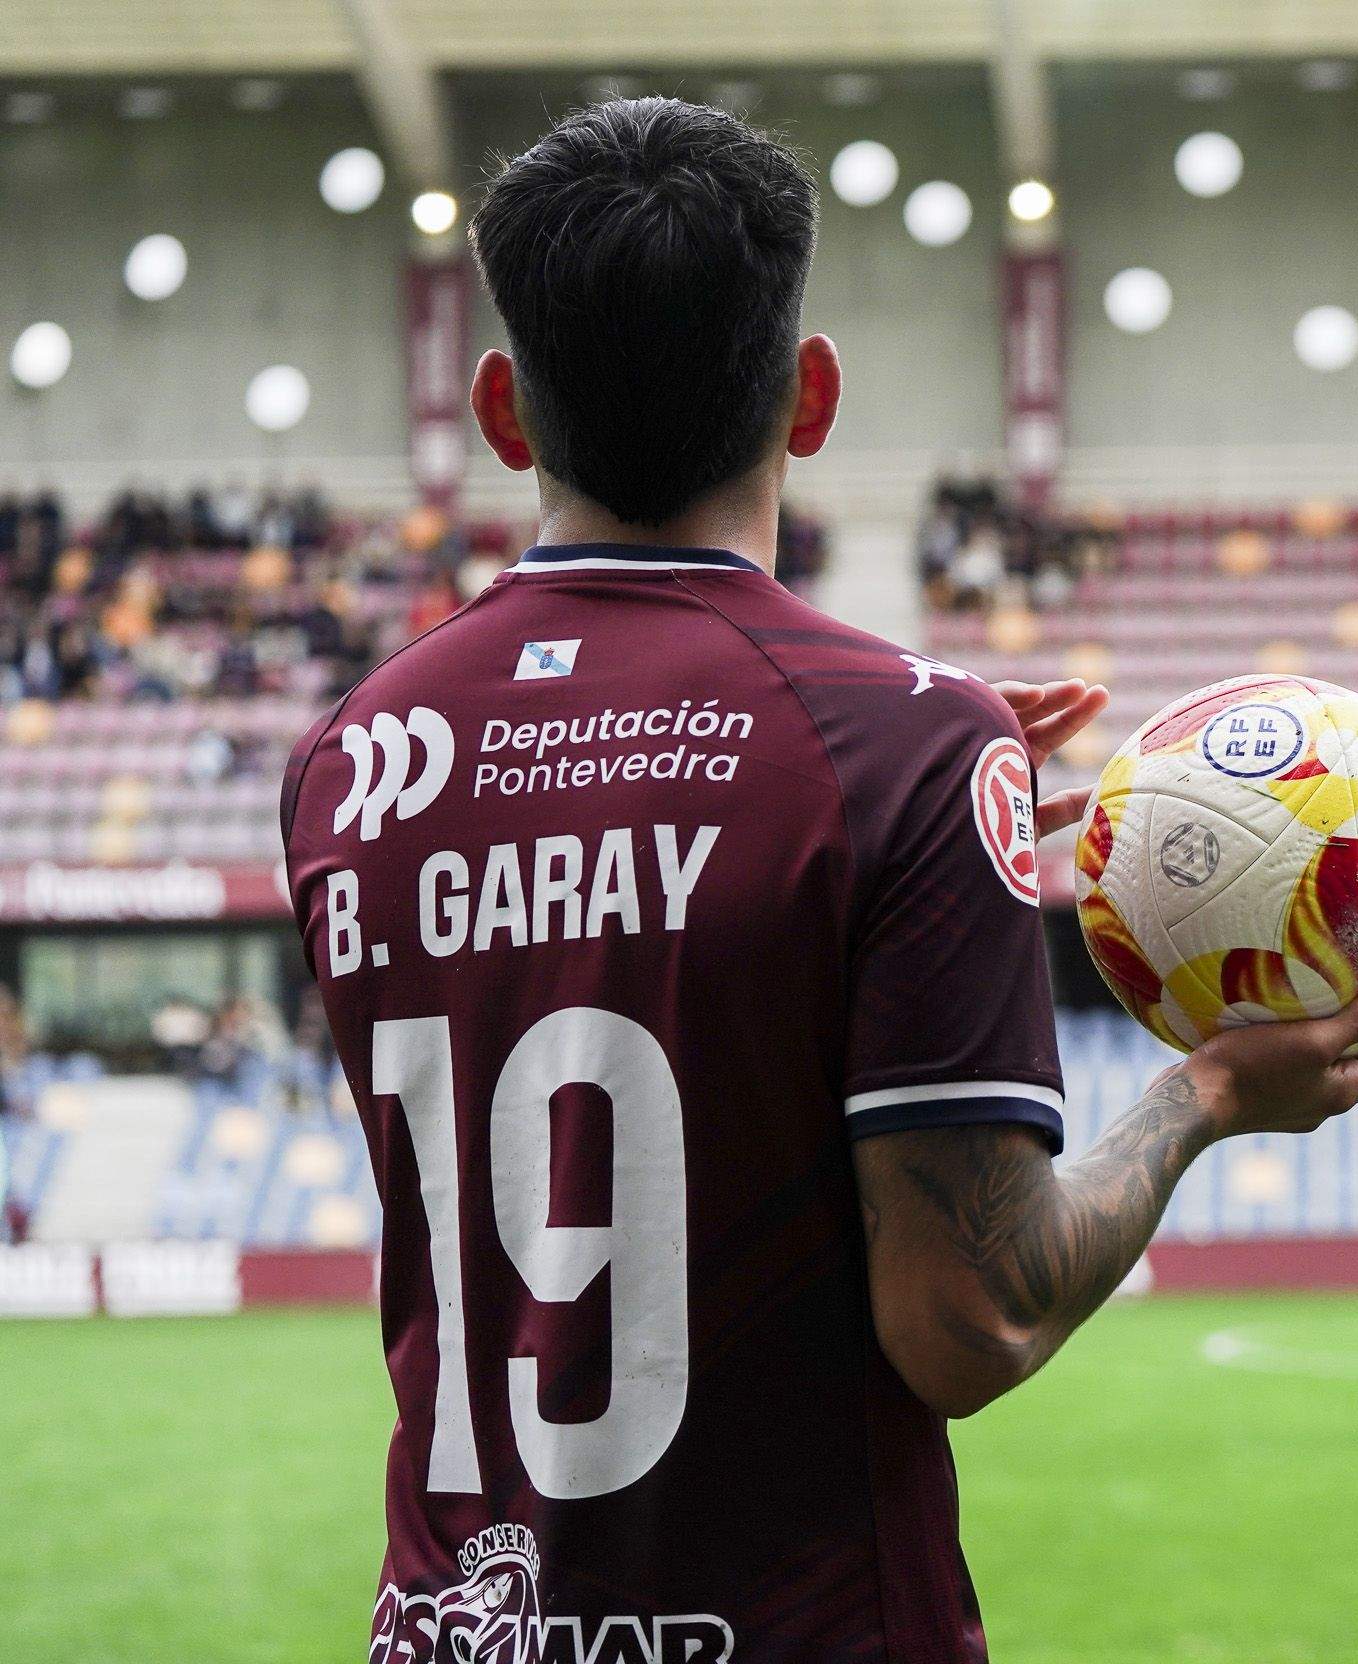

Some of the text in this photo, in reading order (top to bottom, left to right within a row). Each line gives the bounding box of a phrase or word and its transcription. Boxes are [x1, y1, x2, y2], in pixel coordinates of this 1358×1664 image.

[473, 744, 740, 798] Pontevedra
[480, 700, 754, 758] Deputación
[327, 869, 390, 978] B.
[419, 824, 722, 958] GARAY
[372, 1006, 689, 1499] 19
